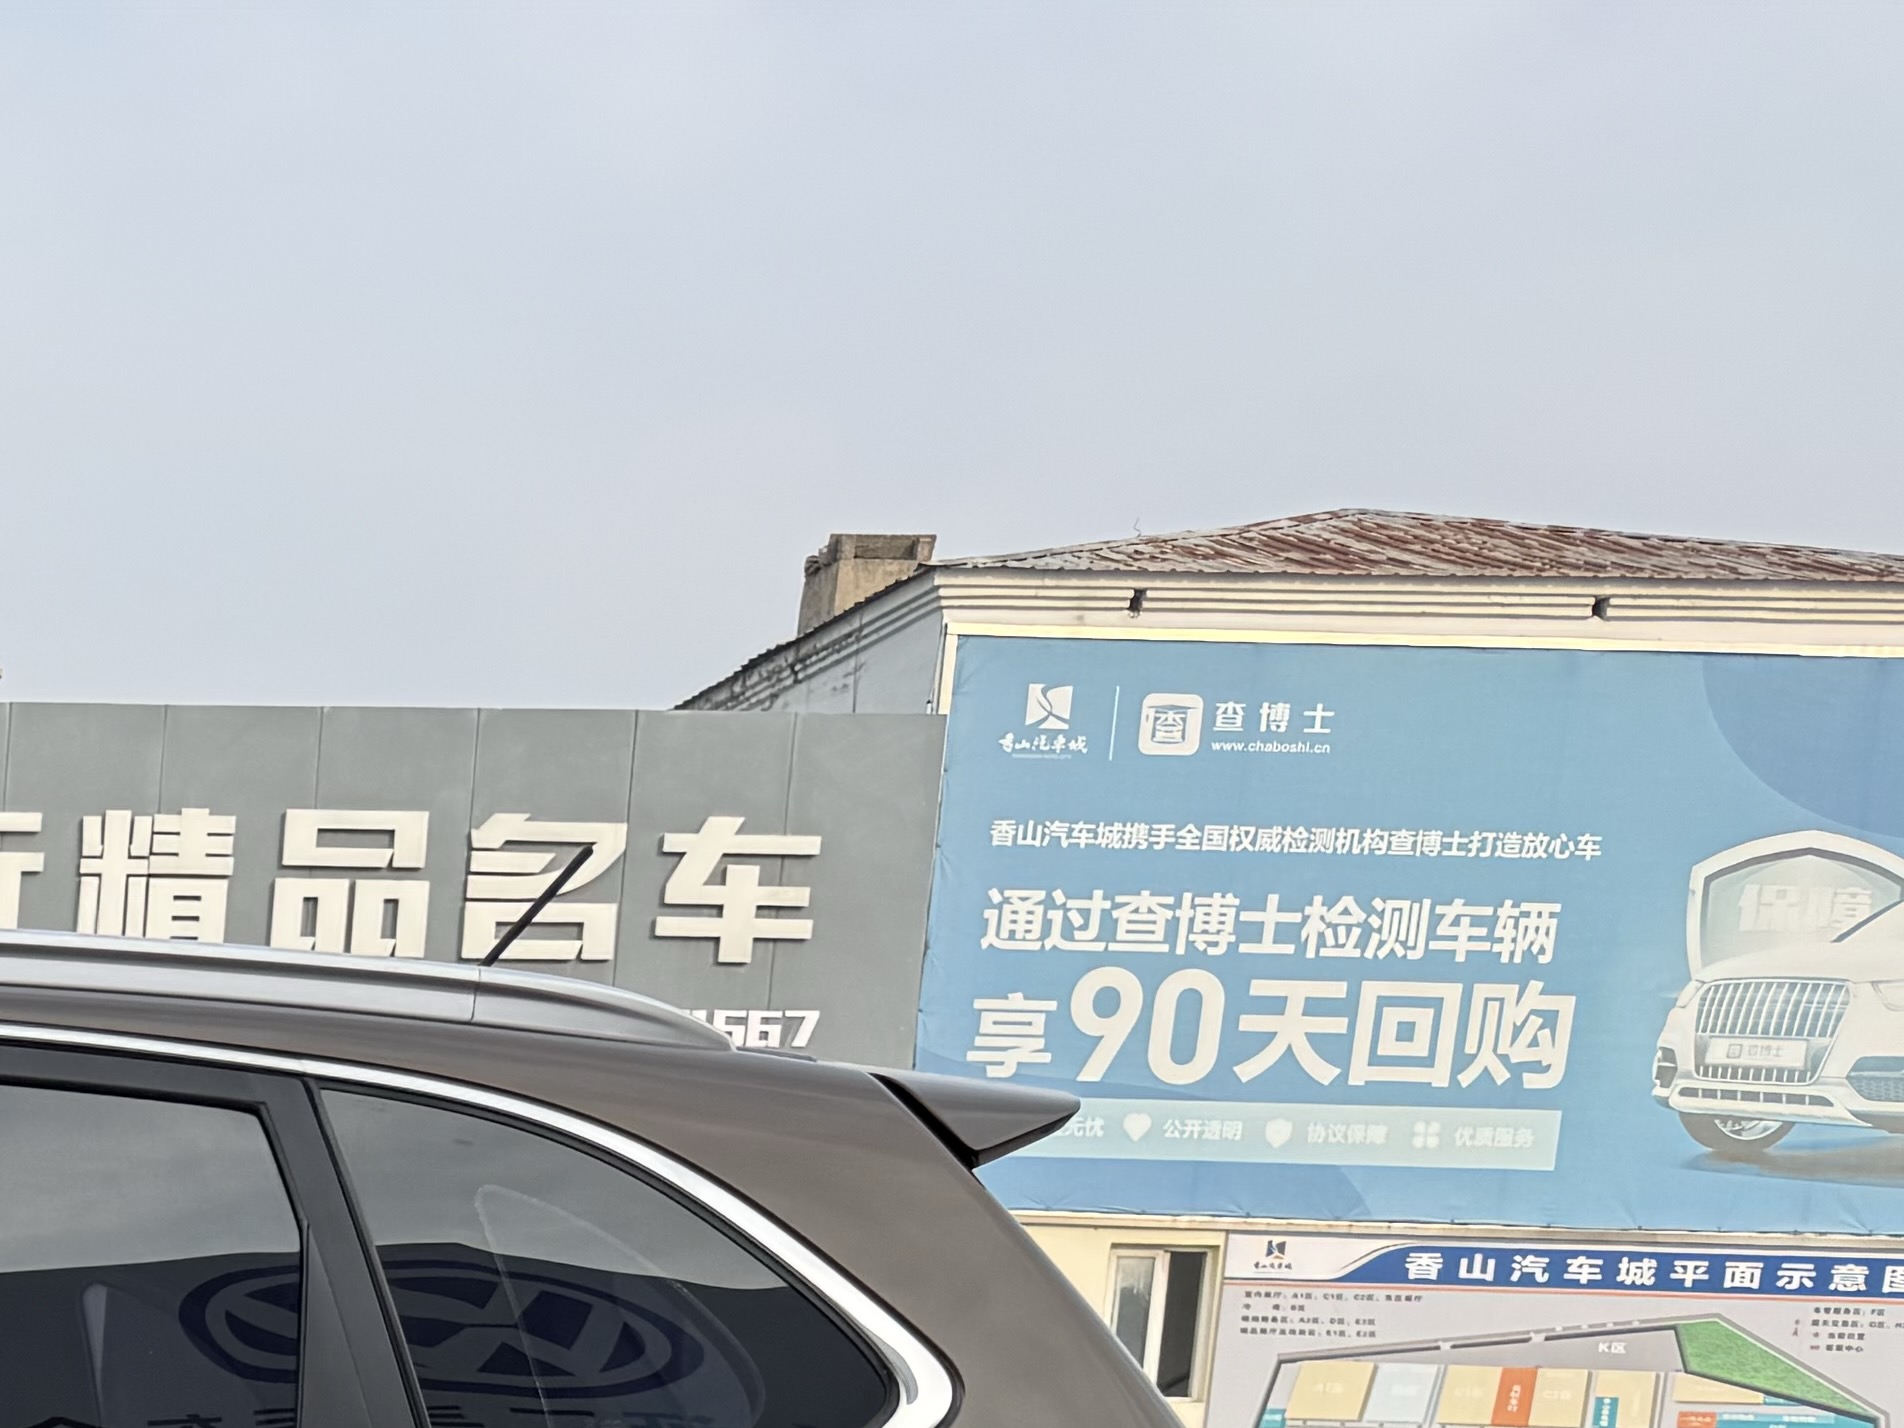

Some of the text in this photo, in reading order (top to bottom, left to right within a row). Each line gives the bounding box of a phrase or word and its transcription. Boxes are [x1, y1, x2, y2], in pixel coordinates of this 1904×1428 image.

[1213, 701, 1335, 734] 查博士
[1210, 740, 1331, 754] www.chaboshi.cn
[989, 819, 1603, 862] 香山汽车城携手全国权威检测机构查博士打造放心车
[980, 887, 1563, 964] 通过查博士检测车辆
[966, 966, 1577, 1089] 享90天回购
[1162, 1119, 1243, 1142] 公开透明
[1306, 1121, 1389, 1146] 协议保障
[1453, 1125, 1536, 1149] 优质服务
